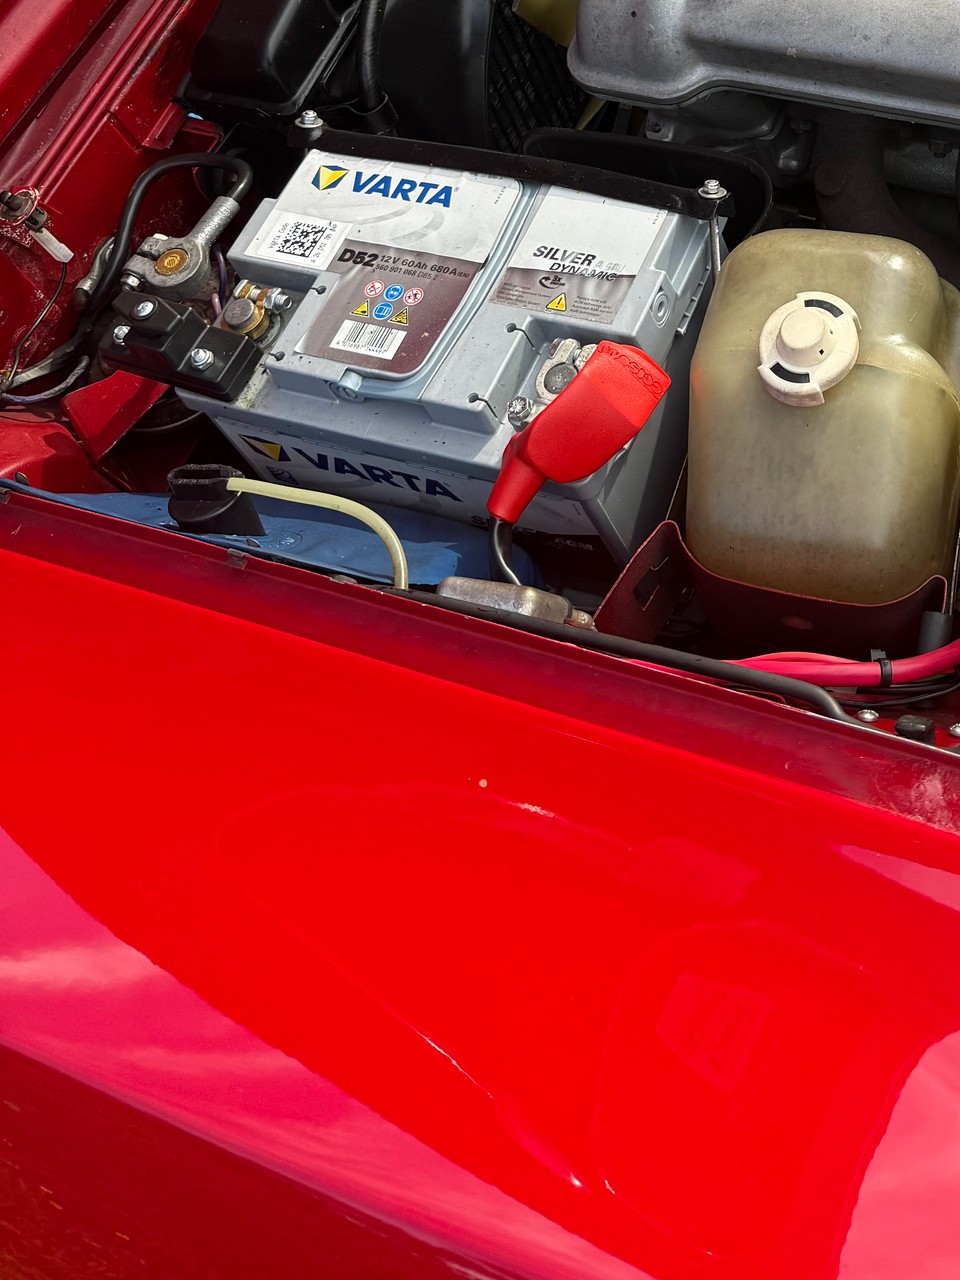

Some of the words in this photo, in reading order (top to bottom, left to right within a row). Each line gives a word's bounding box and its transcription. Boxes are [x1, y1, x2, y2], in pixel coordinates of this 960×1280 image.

[352, 171, 453, 208] VARTA
[337, 248, 379, 268] D52
[533, 245, 597, 267] SILVER
[375, 264, 389, 273] 560
[390, 266, 402, 275] 901
[403, 269, 417, 278] 068
[549, 262, 620, 282] DYNAMIC
[292, 446, 463, 503] VARTA
